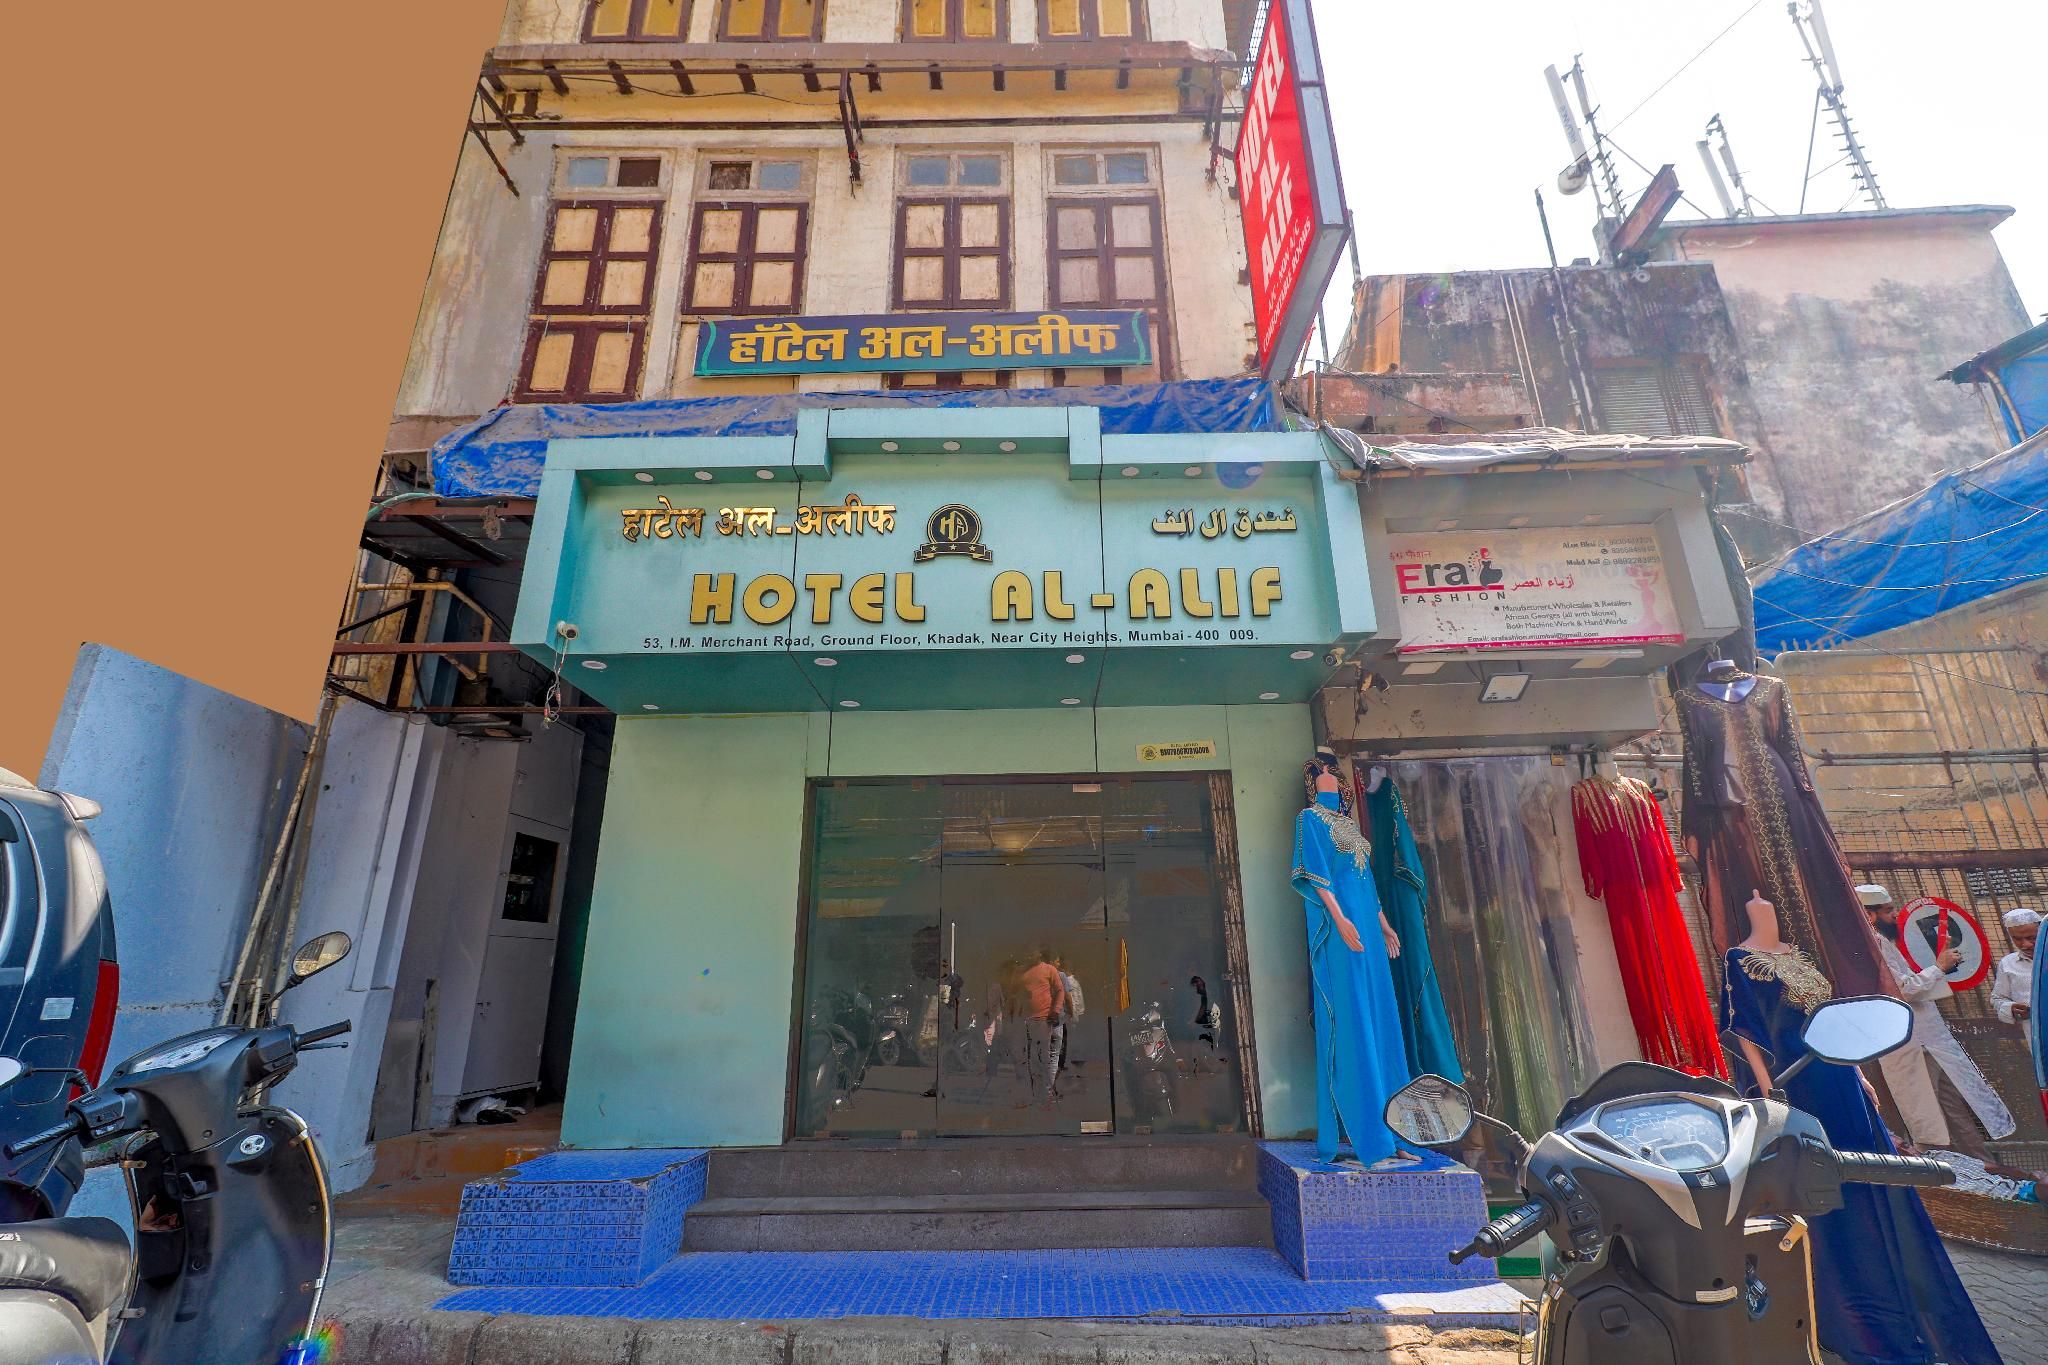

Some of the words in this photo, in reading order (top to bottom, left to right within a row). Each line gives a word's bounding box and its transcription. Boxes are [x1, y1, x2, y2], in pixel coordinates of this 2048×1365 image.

[1239, 19, 1284, 207] HOTEL
[1259, 137, 1280, 222] AL
[1261, 161, 1293, 293] ALIF
[729, 321, 849, 364] हॉटेल
[1232, 506, 1298, 539] فندق
[1396, 562, 1469, 594] Era
[689, 572, 927, 625] HOTEL
[1402, 591, 1506, 604] FASHION
[1505, 612, 1529, 621] African
[1531, 612, 1560, 621] Georges
[1507, 622, 1524, 630] Both
[643, 637, 663, 650] 53,
[670, 636, 695, 648] I.M.
[701, 636, 768, 648] Merchant
[773, 635, 815, 648] Road,
[821, 634, 874, 646] Ground
[880, 633, 921, 647] Floor,
[927, 632, 985, 646] Khadak,
[991, 632, 1024, 644] Near
[1029, 631, 1058, 645] City
[1063, 630, 1122, 645] Heights,
[1229, 629, 1259, 641] 009.
[1468, 635, 1490, 643] Email:
